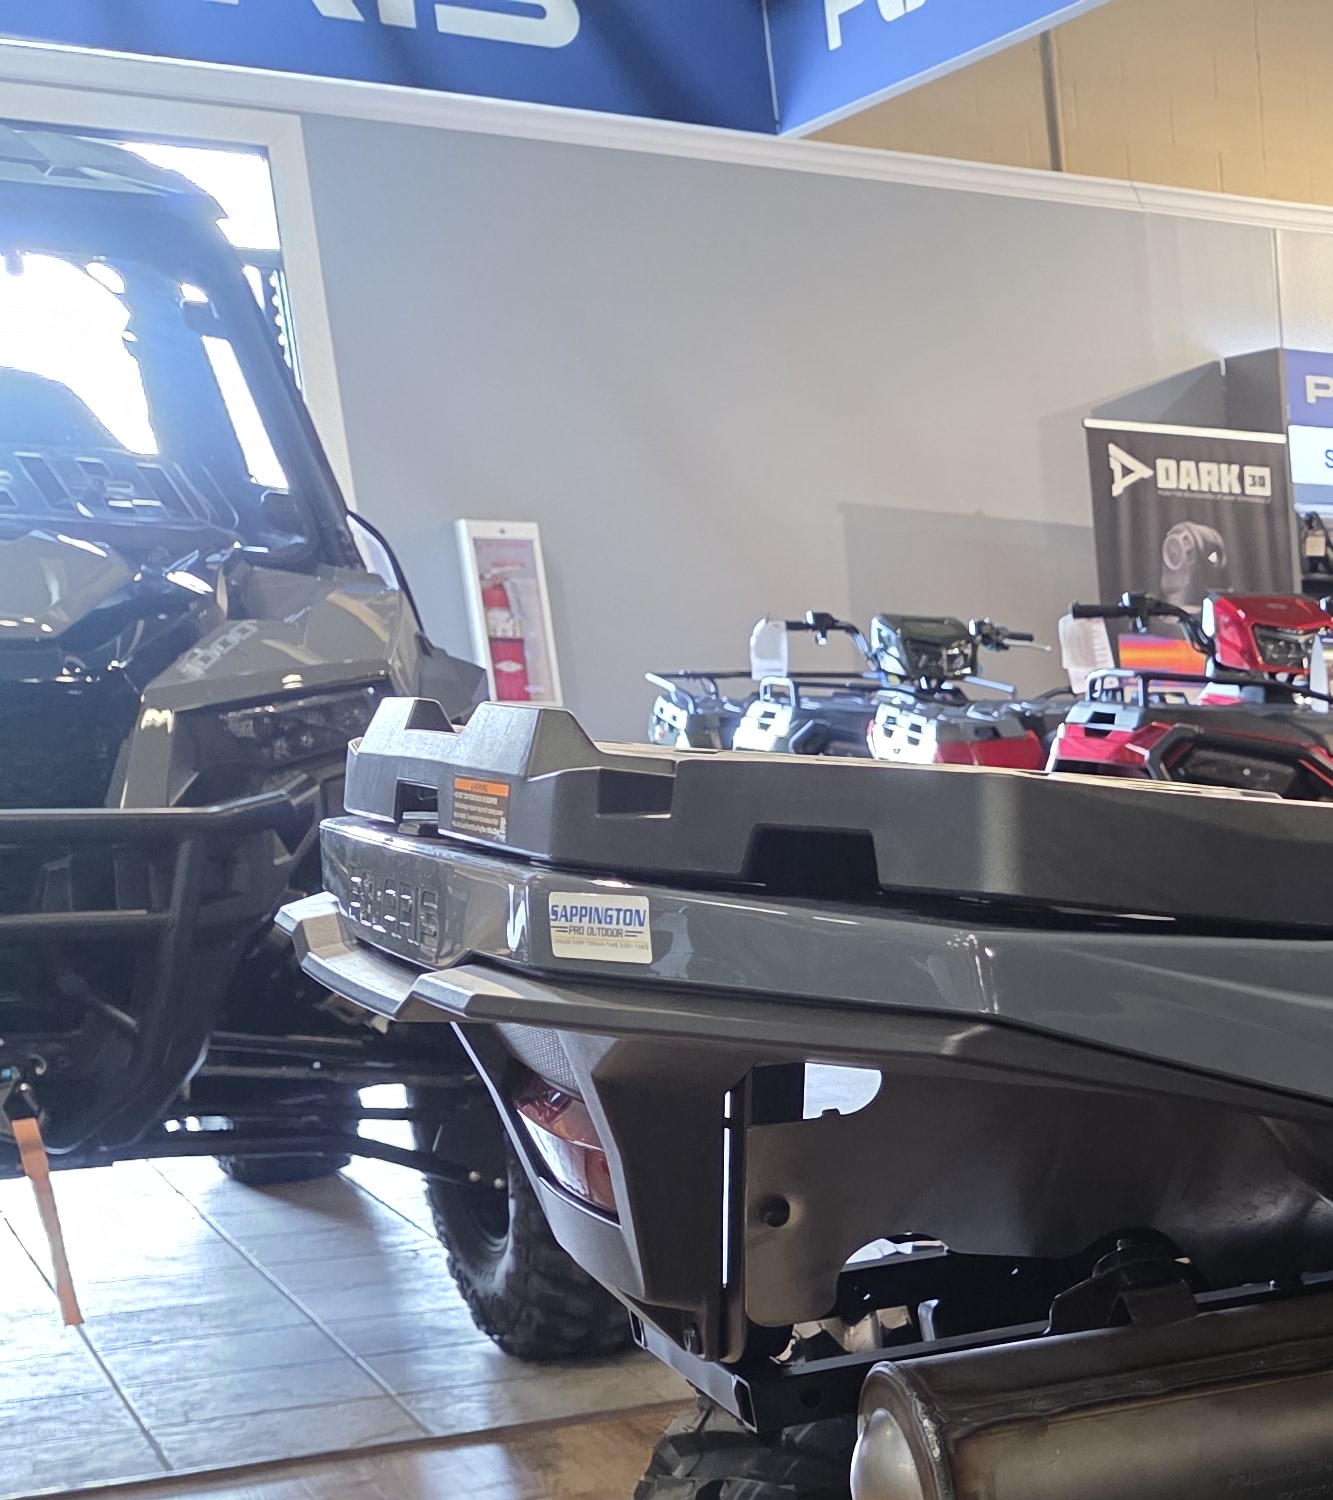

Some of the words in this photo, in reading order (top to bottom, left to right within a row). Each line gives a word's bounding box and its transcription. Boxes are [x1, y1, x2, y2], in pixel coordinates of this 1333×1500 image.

[1155, 458, 1242, 494] DARK
[550, 904, 647, 927] SAPPINGTON
[568, 925, 585, 935] PRO
[586, 927, 624, 938] OUTDOOR
